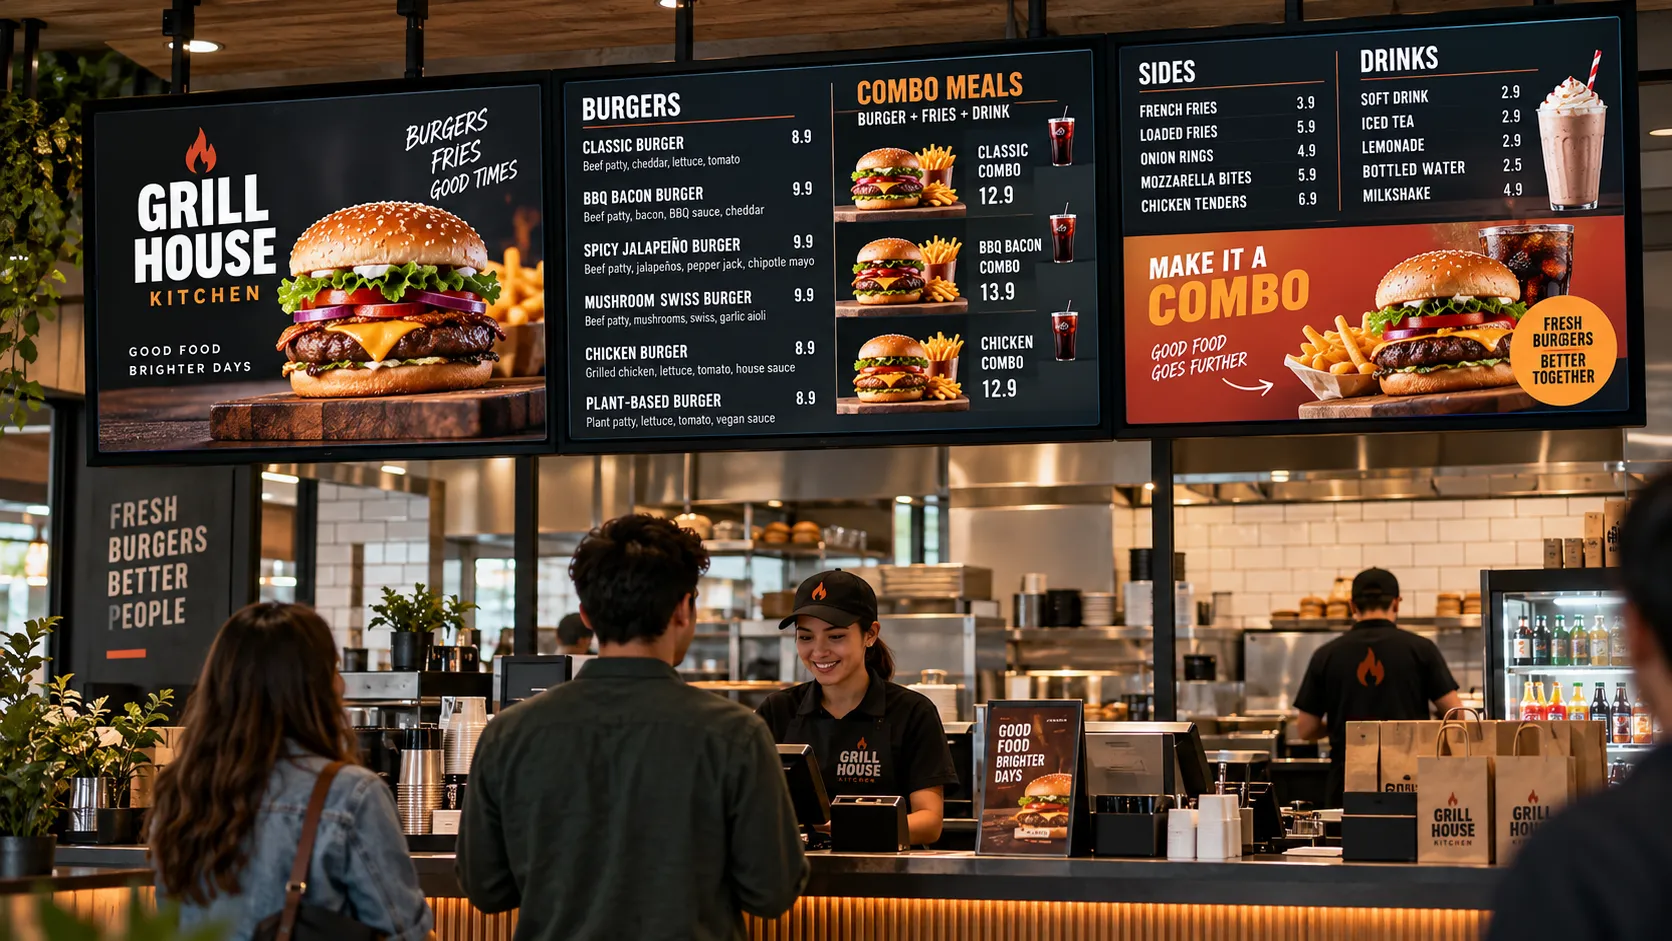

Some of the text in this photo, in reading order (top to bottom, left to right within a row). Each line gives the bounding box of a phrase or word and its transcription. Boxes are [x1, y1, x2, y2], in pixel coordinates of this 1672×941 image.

[1361, 46, 1438, 72] DRINKS
[1139, 60, 1195, 85] SIDES
[858, 72, 1022, 105] COMBO MEALS
[1502, 85, 1519, 98] 2.9
[1297, 96, 1314, 109] 3.9
[1361, 90, 1428, 105] SOFT DRINK
[583, 93, 680, 120] BURGERS
[1140, 102, 1217, 117] FRENCH FRIES
[858, 110, 905, 126] BURGER
[922, 107, 956, 122] FRIES
[973, 104, 1009, 119] DRINK
[1362, 115, 1414, 130] ICED TEA
[1502, 109, 1520, 123] 2.9
[405, 108, 487, 151] BURGERS
[1141, 125, 1217, 141] LOADED FRIES
[1298, 120, 1315, 133] 5.9
[792, 129, 811, 143] 8.9
[1503, 134, 1520, 147] 2.9
[583, 136, 683, 154] CLASSIC BURGER
[979, 144, 1028, 159] CLASSIC
[1298, 144, 1315, 157] 4.9
[1363, 138, 1424, 153] LEMONADE
[432, 139, 481, 174] FRIES
[584, 155, 740, 172] Beef patty, cheddar, lettuce, tomato
[1141, 149, 1213, 165] ONION RINGS
[979, 163, 1020, 178] COMBO
[1363, 161, 1465, 178] BOTTLED WATER
[1504, 158, 1521, 171] 2.5
[431, 159, 517, 200] GOOD TIMES
[1141, 171, 1251, 189] MOZZARELLA BITES
[1299, 168, 1316, 181] 5.9
[793, 181, 812, 195] 9.9
[979, 186, 1013, 204] 12.9
[1364, 187, 1430, 202] MILKSHAKE
[1504, 183, 1522, 196] 4.9
[138, 174, 268, 231] GRILL
[584, 187, 703, 205] BBQ BACON BURGER
[1142, 195, 1246, 212] CHICKEN TENDERS
[1299, 192, 1316, 205] 6.9
[584, 204, 764, 223] Beef patty, bacon, BBQ sauce, cheddar
[584, 243, 618, 257] SPICY
[693, 238, 740, 252] BURGER
[794, 234, 813, 248] 9.9
[980, 238, 1041, 254] BBQ BACON
[135, 227, 276, 283] HOUSE
[1150, 246, 1266, 279] MAKE IT A
[585, 257, 814, 275] Beef patty, jalapeños, pepper jack, chipotle mayo
[980, 260, 1019, 274] COMBO
[151, 285, 258, 306] KITCHEN
[795, 288, 813, 302] 9.9
[981, 282, 1014, 301] 13.9
[1149, 269, 1308, 325] COMBO
[585, 290, 751, 309] MUSHROOM SWISS BURGER
[586, 310, 765, 328] Beef patty, mushrooms, swiss, garlic aioli
[1544, 316, 1581, 331] FRESH
[129, 344, 220, 356] GOOD FOOD
[796, 341, 814, 355] 8.9
[981, 335, 1033, 350] CHICKEN
[1152, 335, 1226, 361] GOOD FOOD
[586, 345, 687, 360] CHICKEN BURGER
[982, 356, 1023, 370] COMBO
[1152, 352, 1247, 381] GOES FURTHER
[1542, 353, 1585, 368] BETTER
[130, 362, 250, 375] BRIGHTER DAYS
[586, 367, 615, 378] Grilled
[619, 366, 656, 377] chicken,
[660, 365, 694, 376] lettuce,
[698, 365, 733, 375] tomato,
[736, 364, 764, 373] house
[1533, 369, 1594, 384] TOGETHER
[983, 379, 1016, 397] 12.9
[587, 394, 721, 410] PLANT-BASED BURGER
[797, 391, 815, 405] 8.9
[587, 415, 775, 429] Plant patty, lettuce, tomato, vegan sauce
[111, 496, 176, 529] FRESH
[109, 525, 206, 563] BURGERS
[108, 563, 187, 596] BETTER
[110, 597, 185, 629] PEOPLE
[999, 724, 1031, 737] GOOD
[998, 737, 1029, 752] FOOD
[840, 751, 879, 763] GRILL
[997, 754, 1044, 768] BRIGHTER
[837, 764, 881, 776] HOUSE
[995, 769, 1022, 782] DAYS
[1434, 808, 1472, 822] GRILL
[1432, 823, 1475, 837] HOUSE
